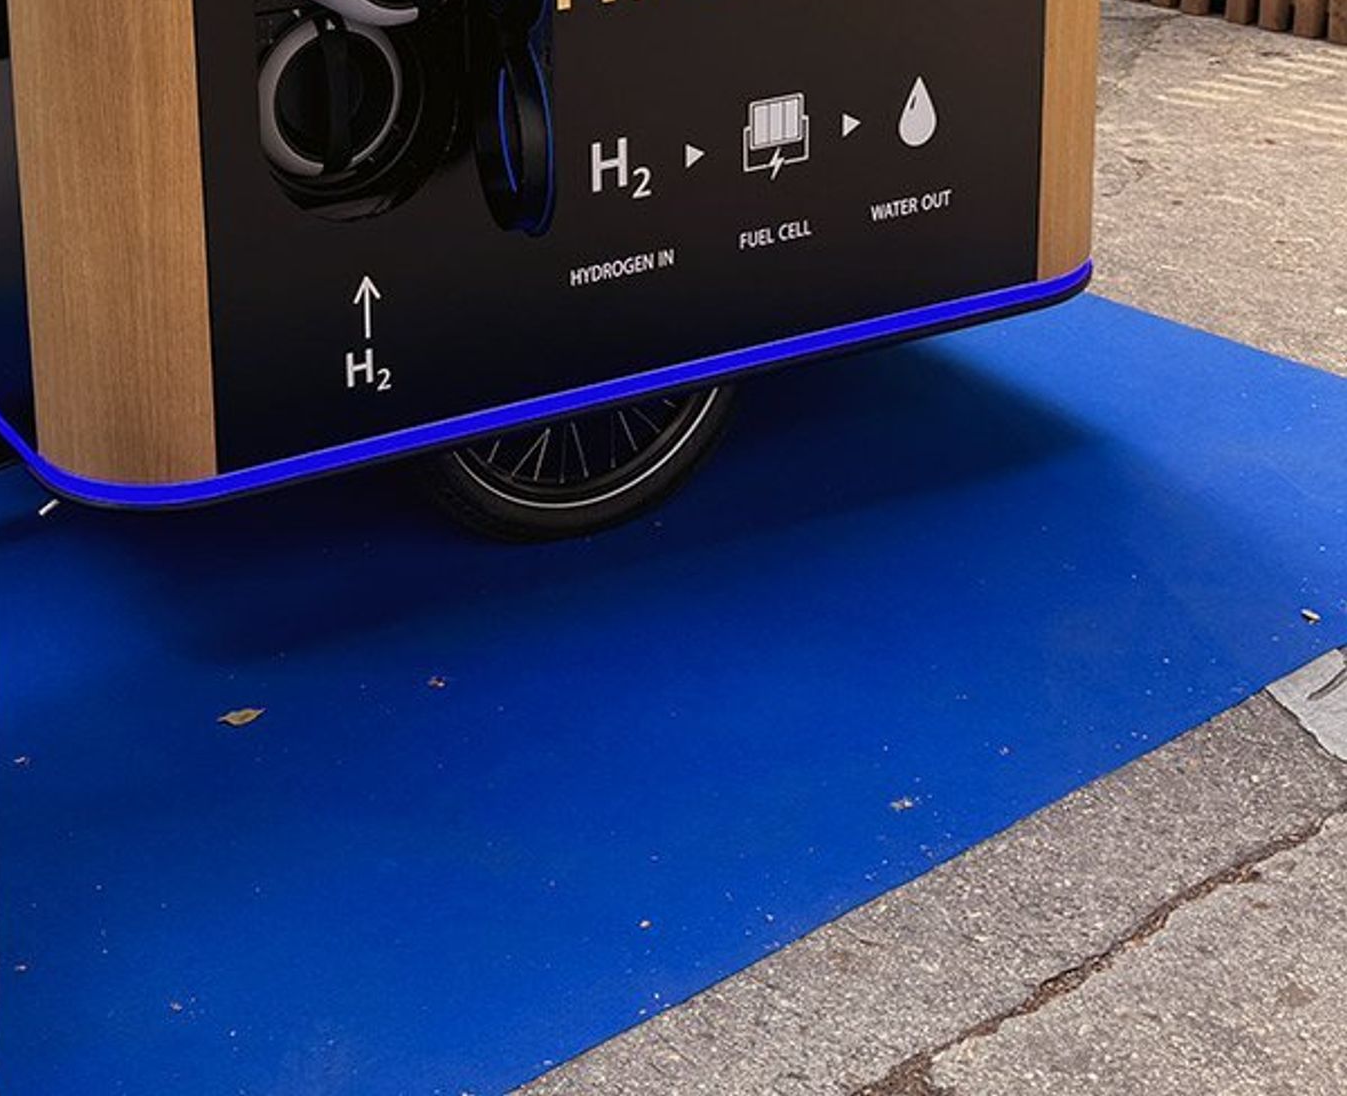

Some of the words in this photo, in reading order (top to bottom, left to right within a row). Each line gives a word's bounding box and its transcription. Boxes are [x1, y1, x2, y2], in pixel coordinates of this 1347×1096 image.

[869, 196, 920, 222] WATER
[920, 188, 953, 212] OUT
[738, 227, 775, 251] FUEL
[777, 219, 813, 243] CELL
[569, 252, 655, 288] HYDROGEN
[656, 248, 676, 269] IN
